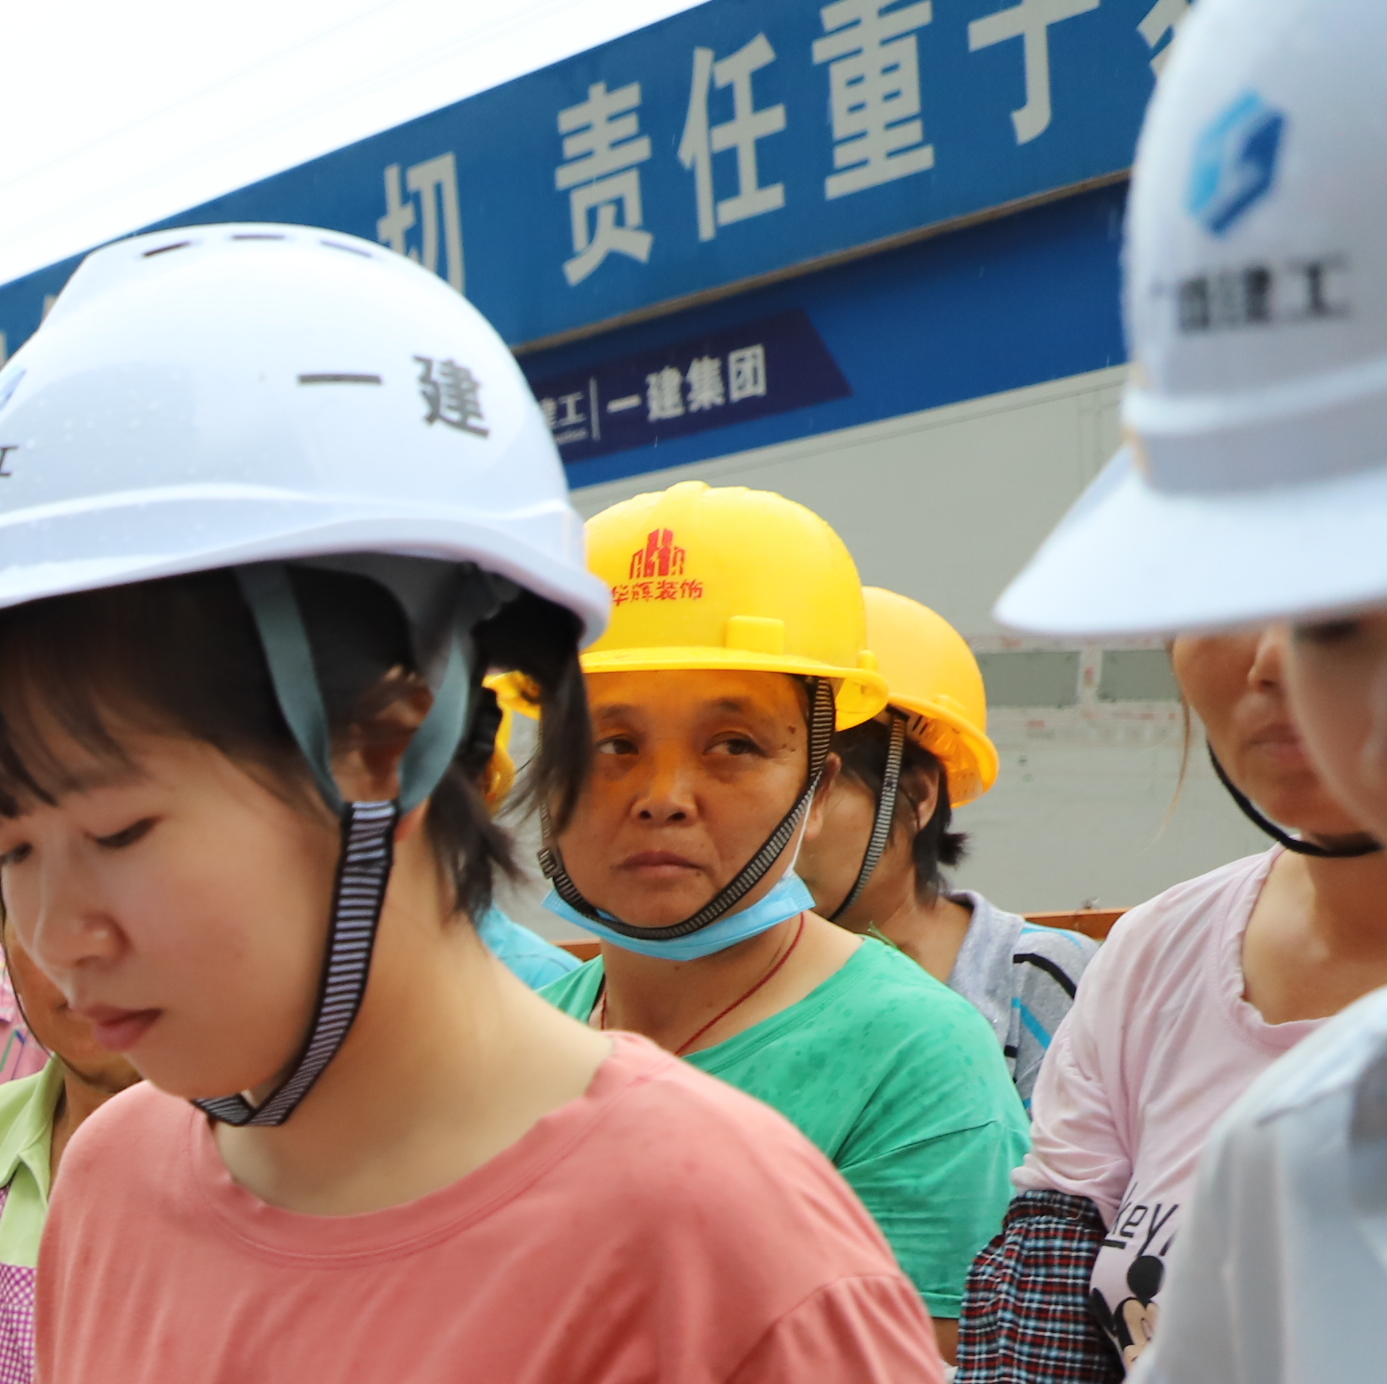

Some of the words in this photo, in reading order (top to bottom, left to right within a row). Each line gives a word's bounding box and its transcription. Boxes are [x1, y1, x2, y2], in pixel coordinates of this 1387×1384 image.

[296, 354, 490, 438] 一建
[606, 343, 767, 423] 一建集团
